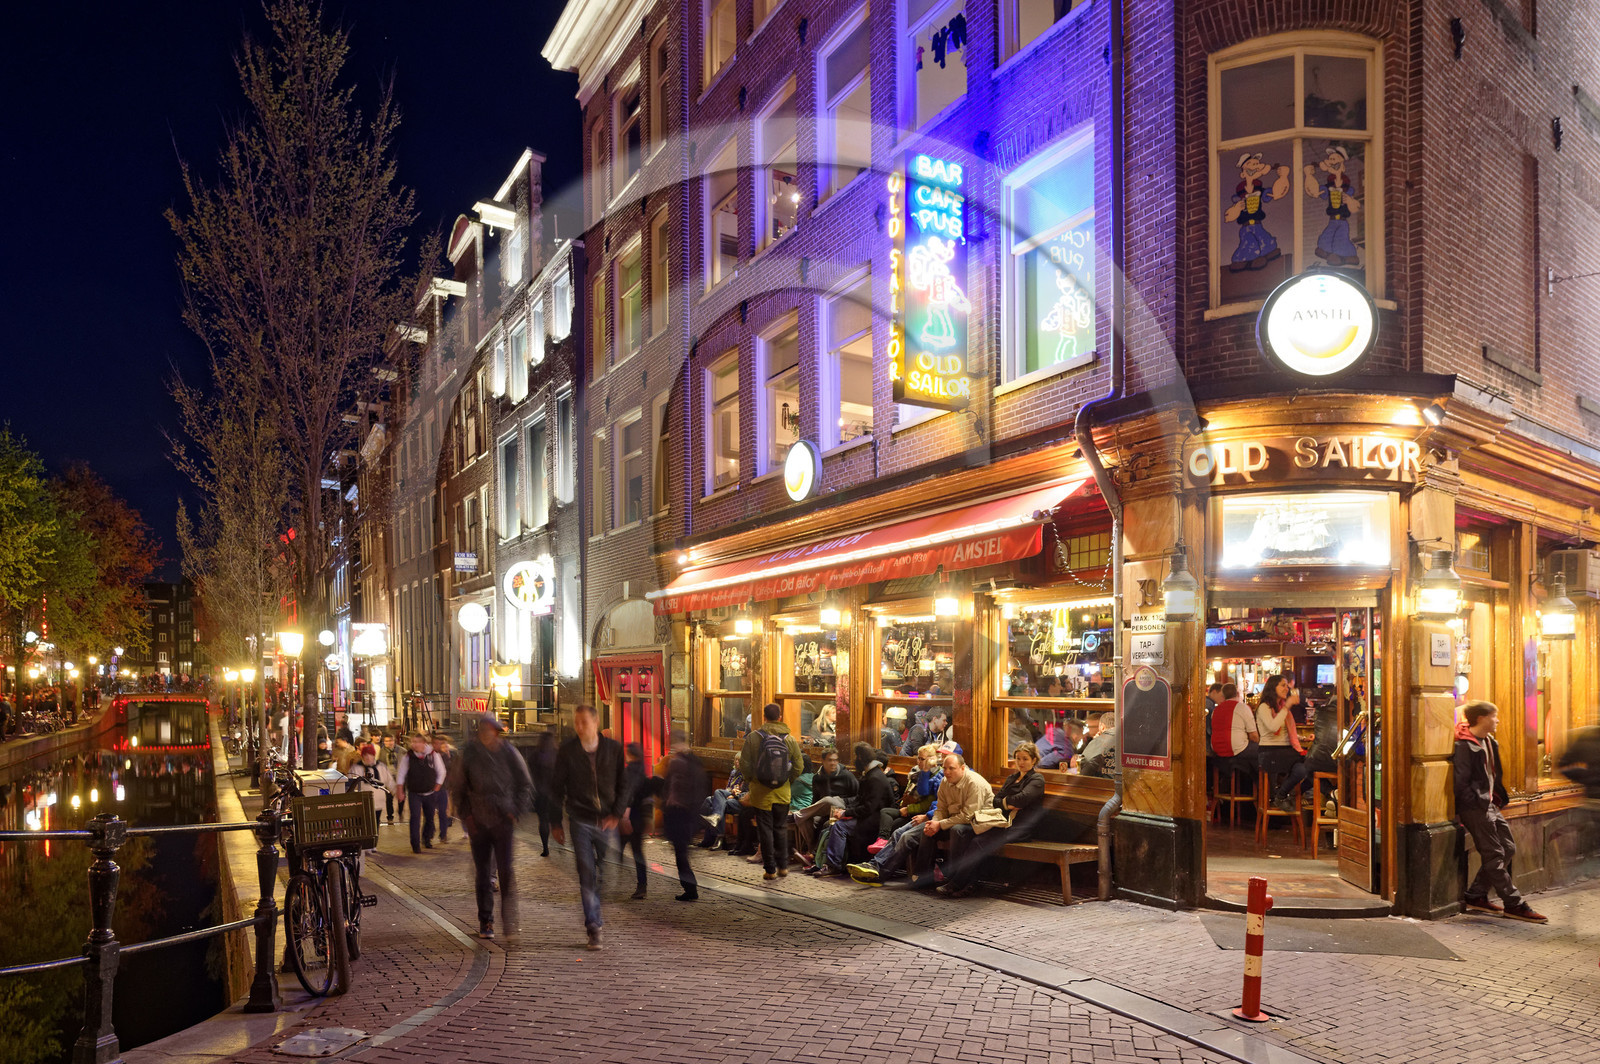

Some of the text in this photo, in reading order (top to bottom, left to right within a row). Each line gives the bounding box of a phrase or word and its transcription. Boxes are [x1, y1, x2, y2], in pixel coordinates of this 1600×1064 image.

[916, 153, 963, 186] BAR
[916, 184, 966, 216] CAFE
[1291, 308, 1353, 323] AMSTEL
[917, 352, 963, 376] OLD
[908, 371, 971, 399] SAILOR
[1188, 436, 1422, 477] OLD SAILOR
[952, 536, 1003, 563] AMSTEL
[1131, 624, 1166, 632] PERSONEN
[1139, 640, 1155, 649] TAP-
[1131, 651, 1164, 660] VERGUNNING
[475, 698, 488, 712] CITY
[1125, 757, 1148, 767] AMSTEL
[1148, 758, 1165, 768] BEER
